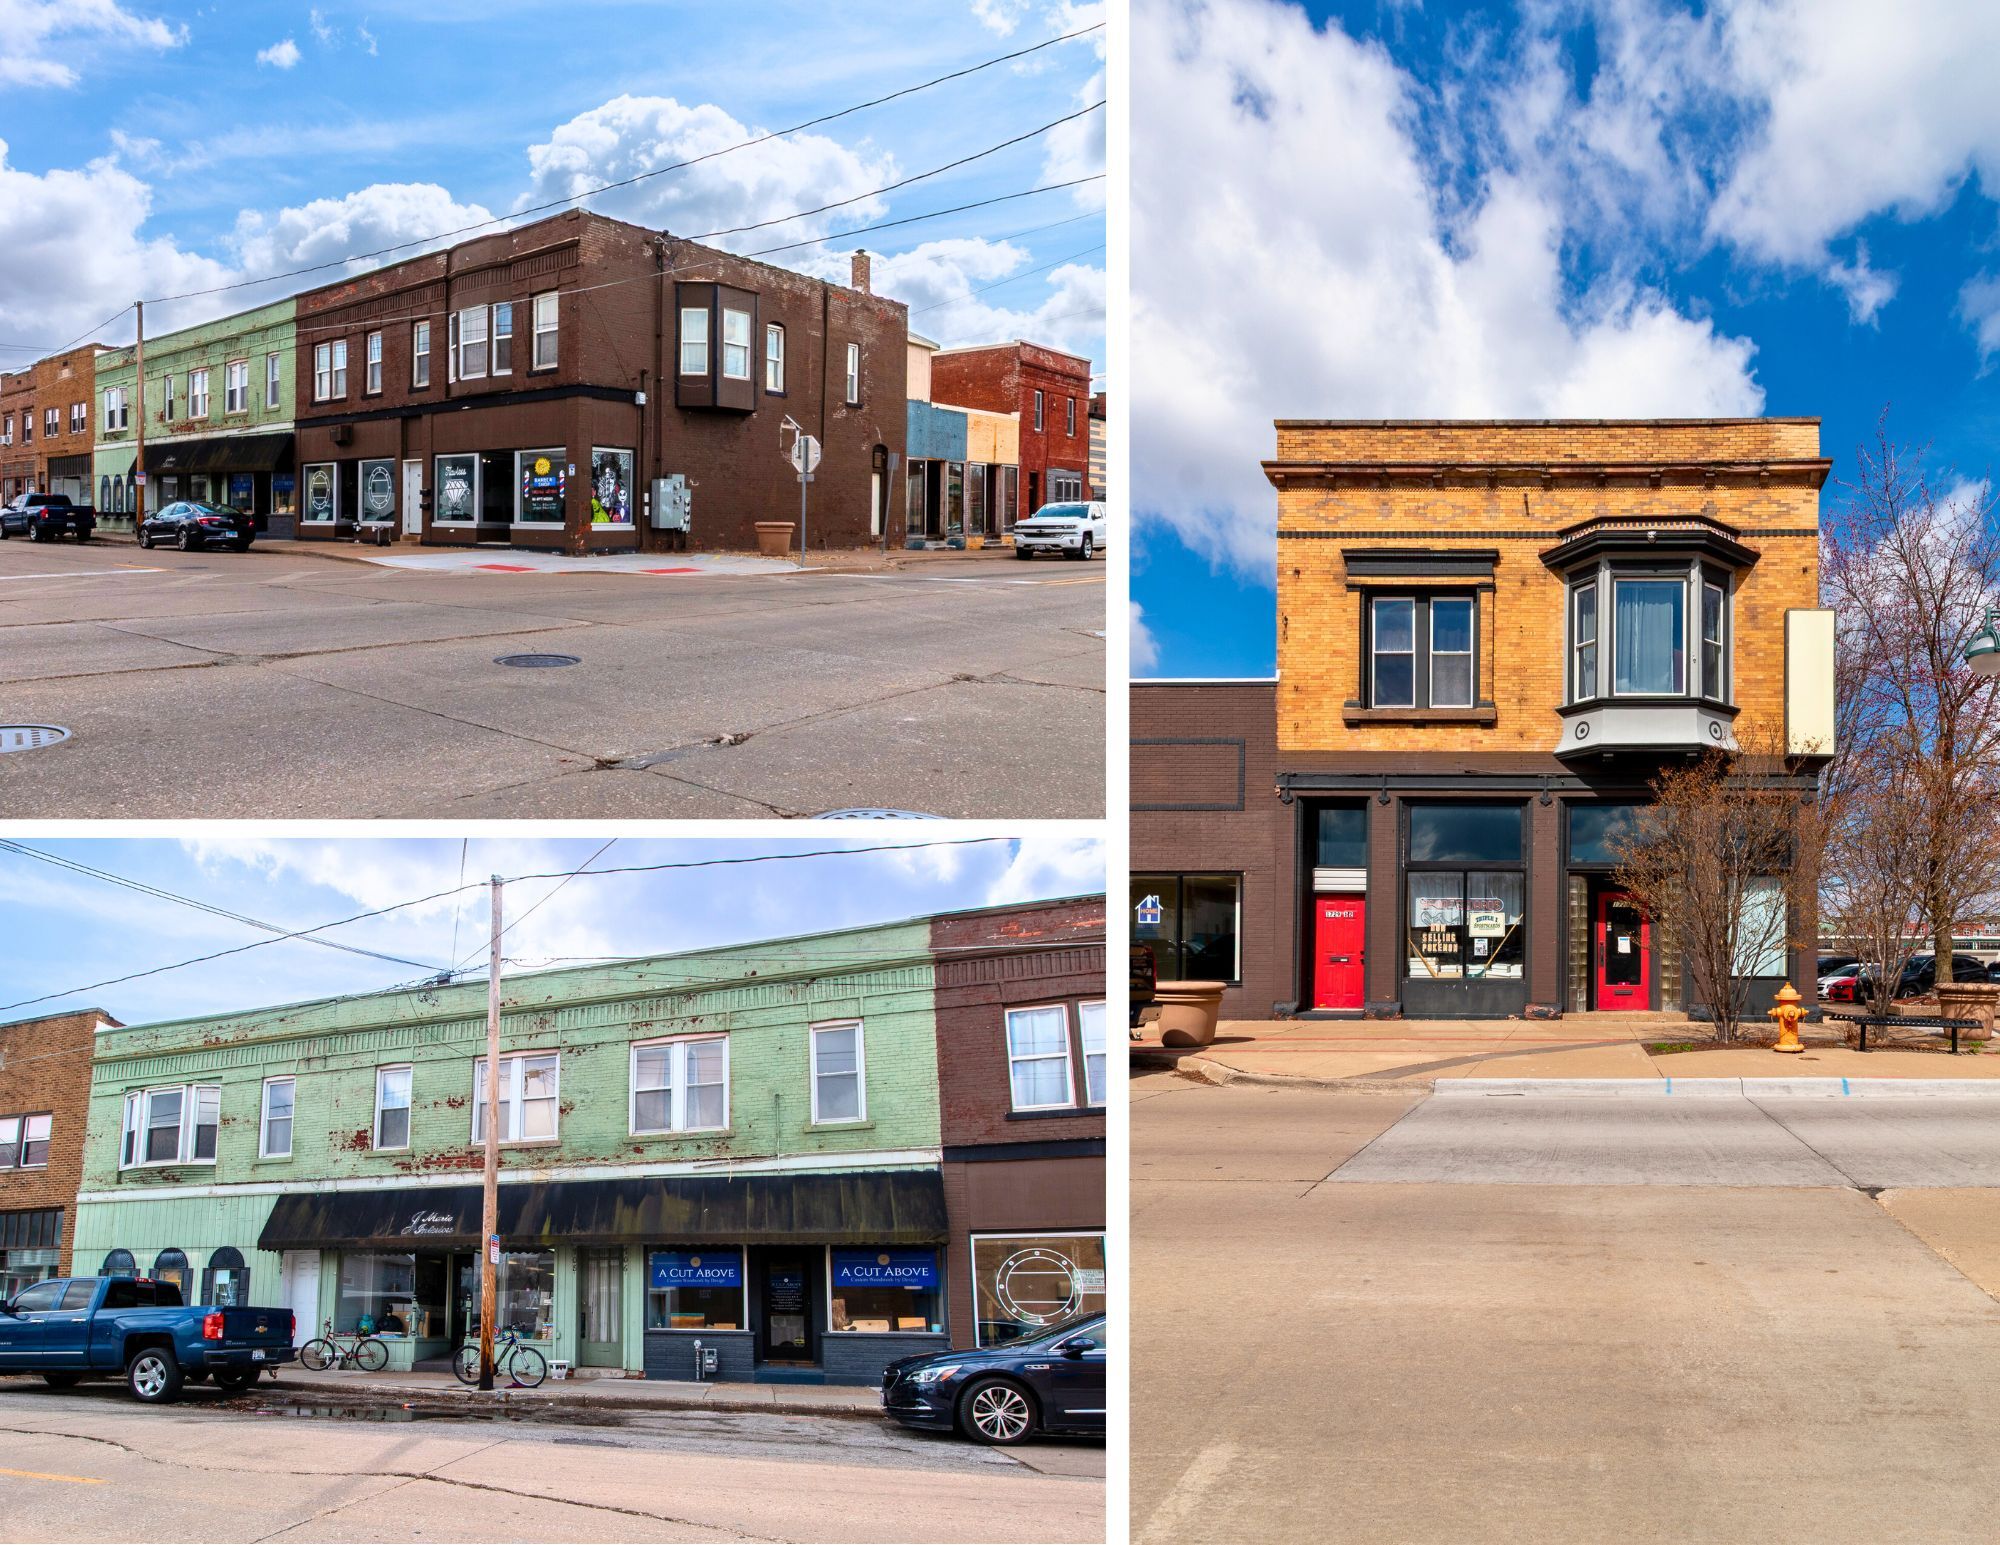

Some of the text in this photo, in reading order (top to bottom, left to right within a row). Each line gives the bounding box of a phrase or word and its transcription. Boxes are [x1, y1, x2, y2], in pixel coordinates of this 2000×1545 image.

[1422, 933, 1456, 942] SELLING
[422, 1212, 454, 1222] Marie
[658, 1268, 735, 1278] A CUT ABOVE
[841, 1266, 929, 1277] A CUT ABOVE
